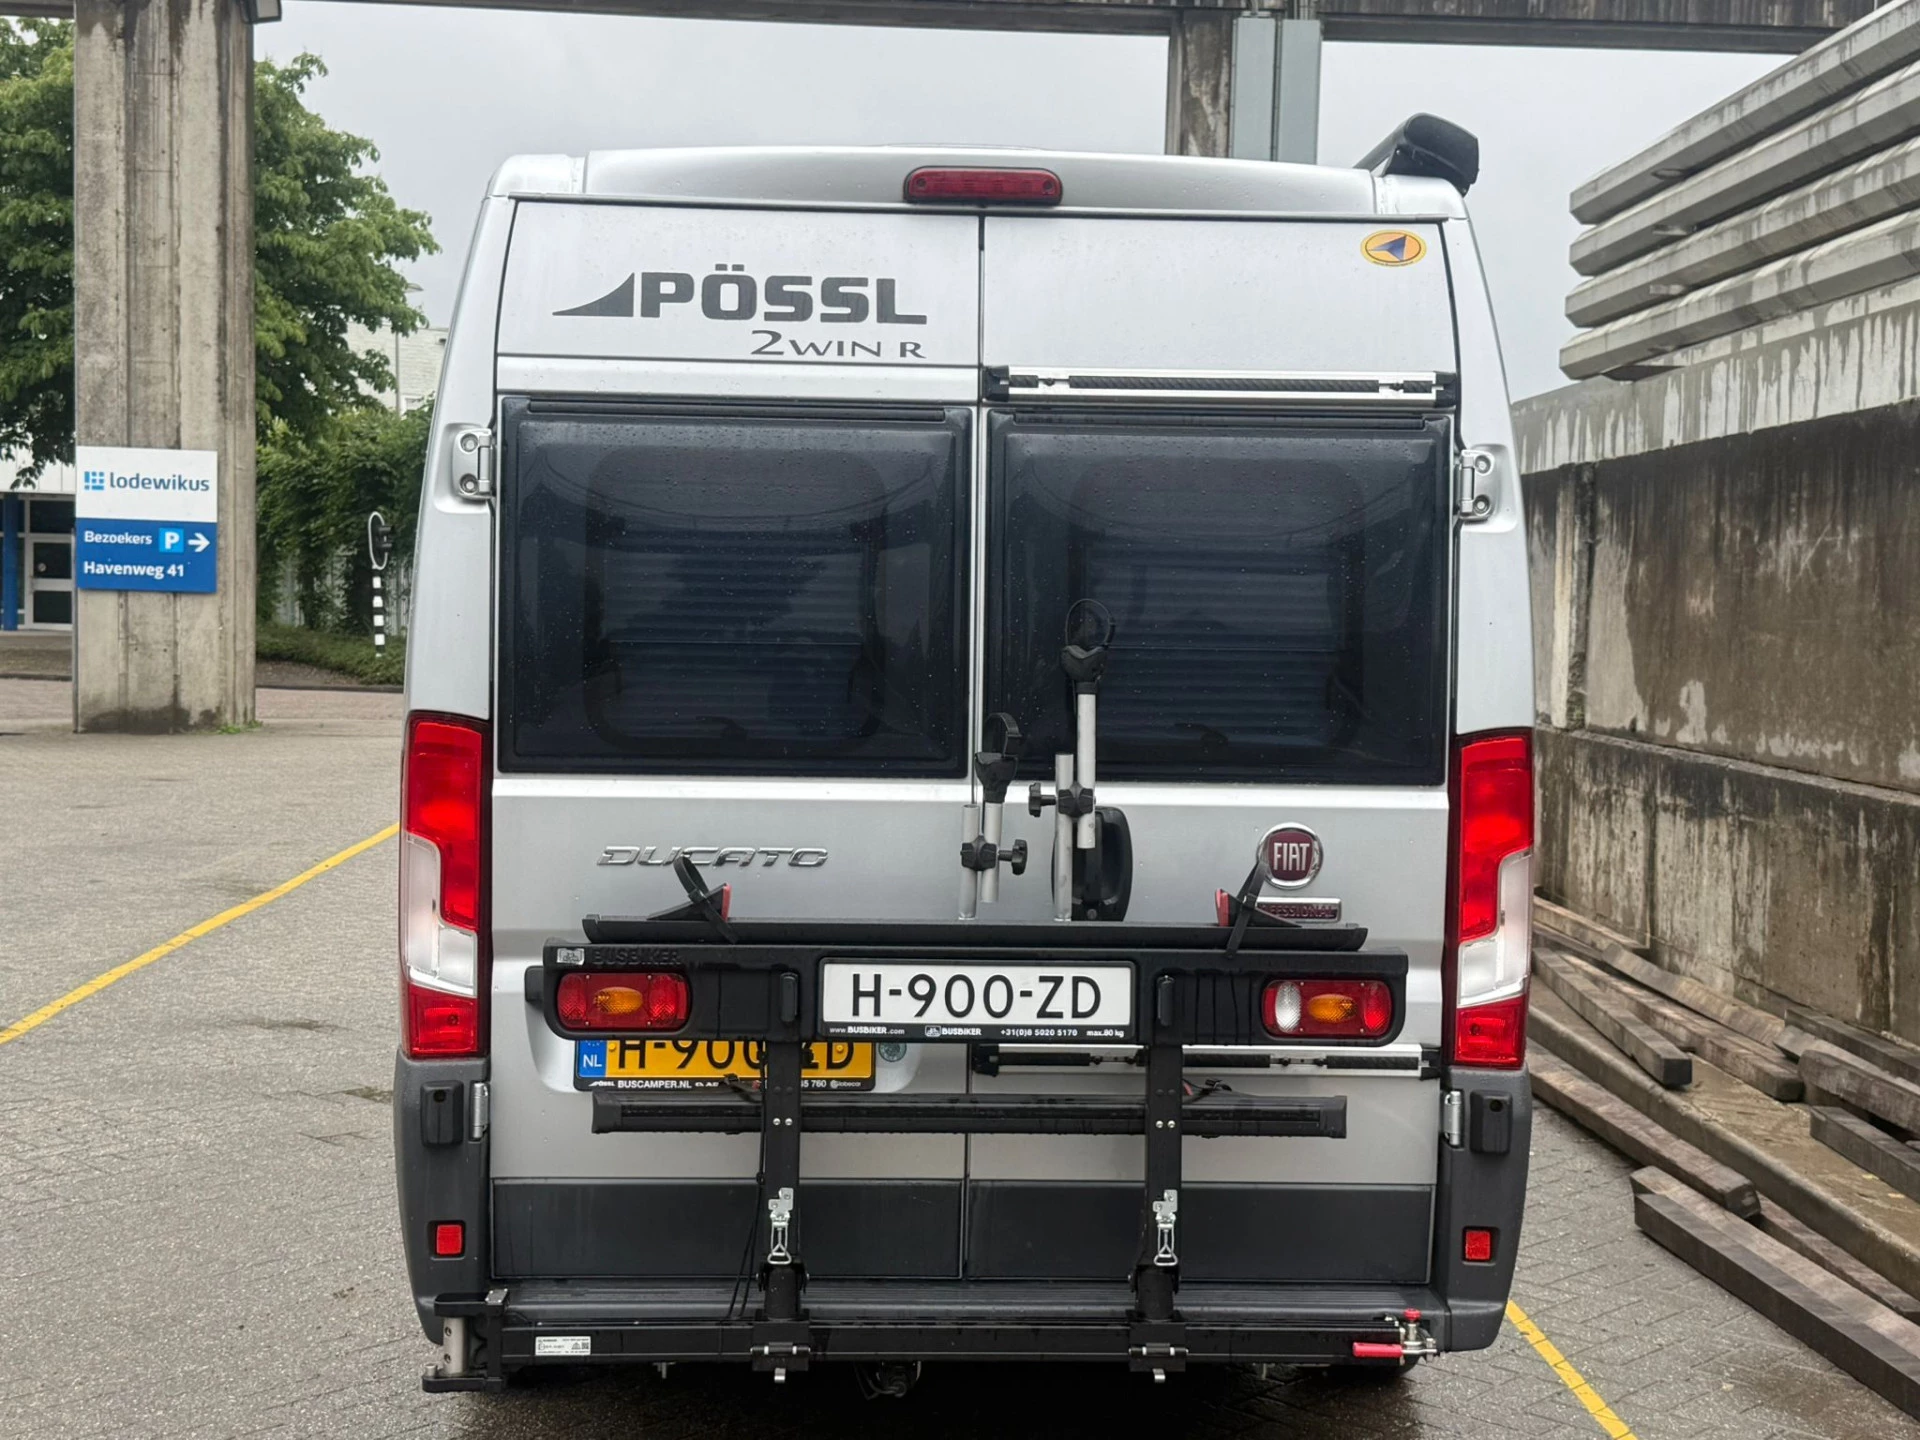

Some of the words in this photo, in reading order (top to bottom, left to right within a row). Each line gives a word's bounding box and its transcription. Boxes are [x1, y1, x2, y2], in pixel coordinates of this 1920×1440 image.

[641, 263, 927, 325] PÖSSL
[751, 330, 881, 358] 2WIN
[900, 342, 927, 358] R
[109, 472, 210, 491] lodewikus
[84, 530, 153, 545] Bezoekers
[165, 531, 180, 549] P
[83, 561, 164, 580] Havenweg
[167, 564, 184, 577] 41
[597, 845, 829, 867] DUCATO
[1273, 842, 1310, 871] FIAT
[852, 973, 1101, 1019] H-900-ZD
[941, 1027, 982, 1036] BUSBIKER
[583, 1054, 602, 1068] NL
[618, 1080, 692, 1089] BUSCAMPER.NL
